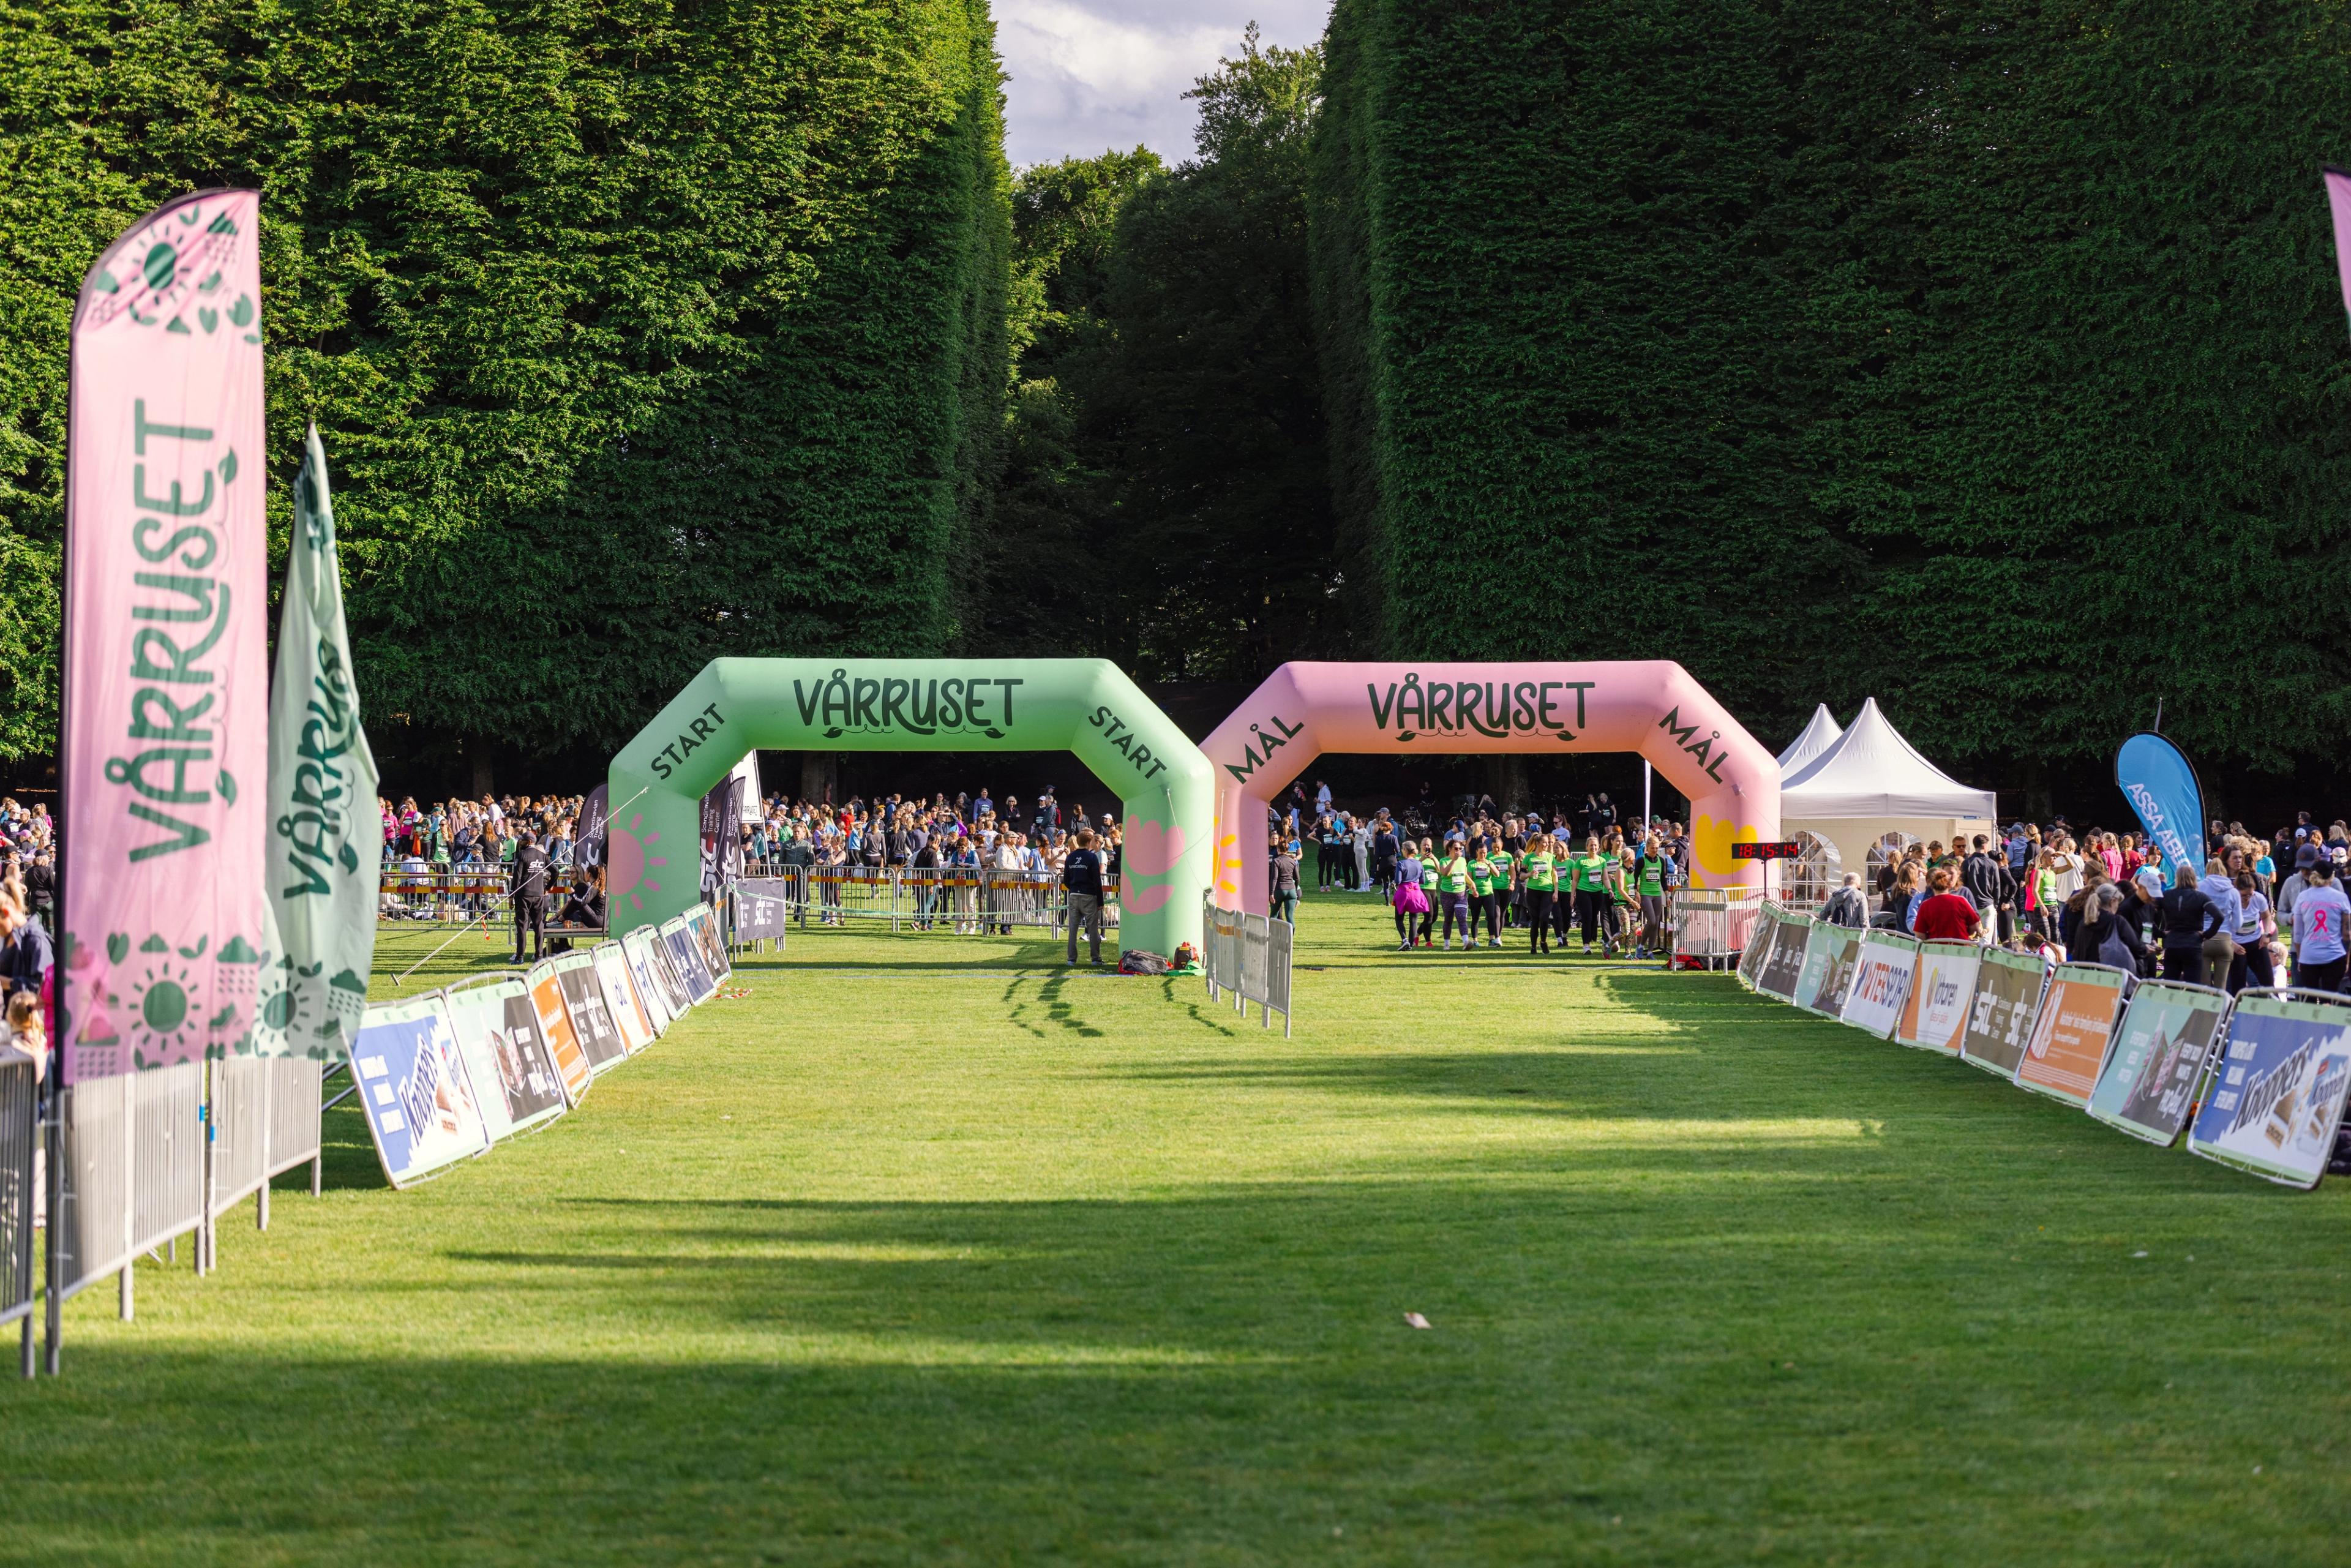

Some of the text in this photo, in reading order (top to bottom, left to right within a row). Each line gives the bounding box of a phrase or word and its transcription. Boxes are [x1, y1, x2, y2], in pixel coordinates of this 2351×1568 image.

[105, 399, 231, 863] VÅRRUSET
[793, 669, 1023, 735] VÅRRUSET
[1367, 672, 1595, 738] VÅRRUSET
[651, 702, 725, 779] START
[1088, 706, 1167, 779] START
[1223, 716, 1304, 784] MÅL
[1659, 705, 1728, 784] MÅL
[2127, 783, 2164, 830] ASSA
[529, 859, 544, 868] stc
[700, 838, 717, 894] stc
[1739, 844, 1797, 857] 18:15:14
[1970, 980, 1998, 1036] stc
[2004, 988, 2028, 1046] stc
[401, 1037, 438, 1147] Knoppers
[2232, 1040, 2312, 1134] Knoppers
